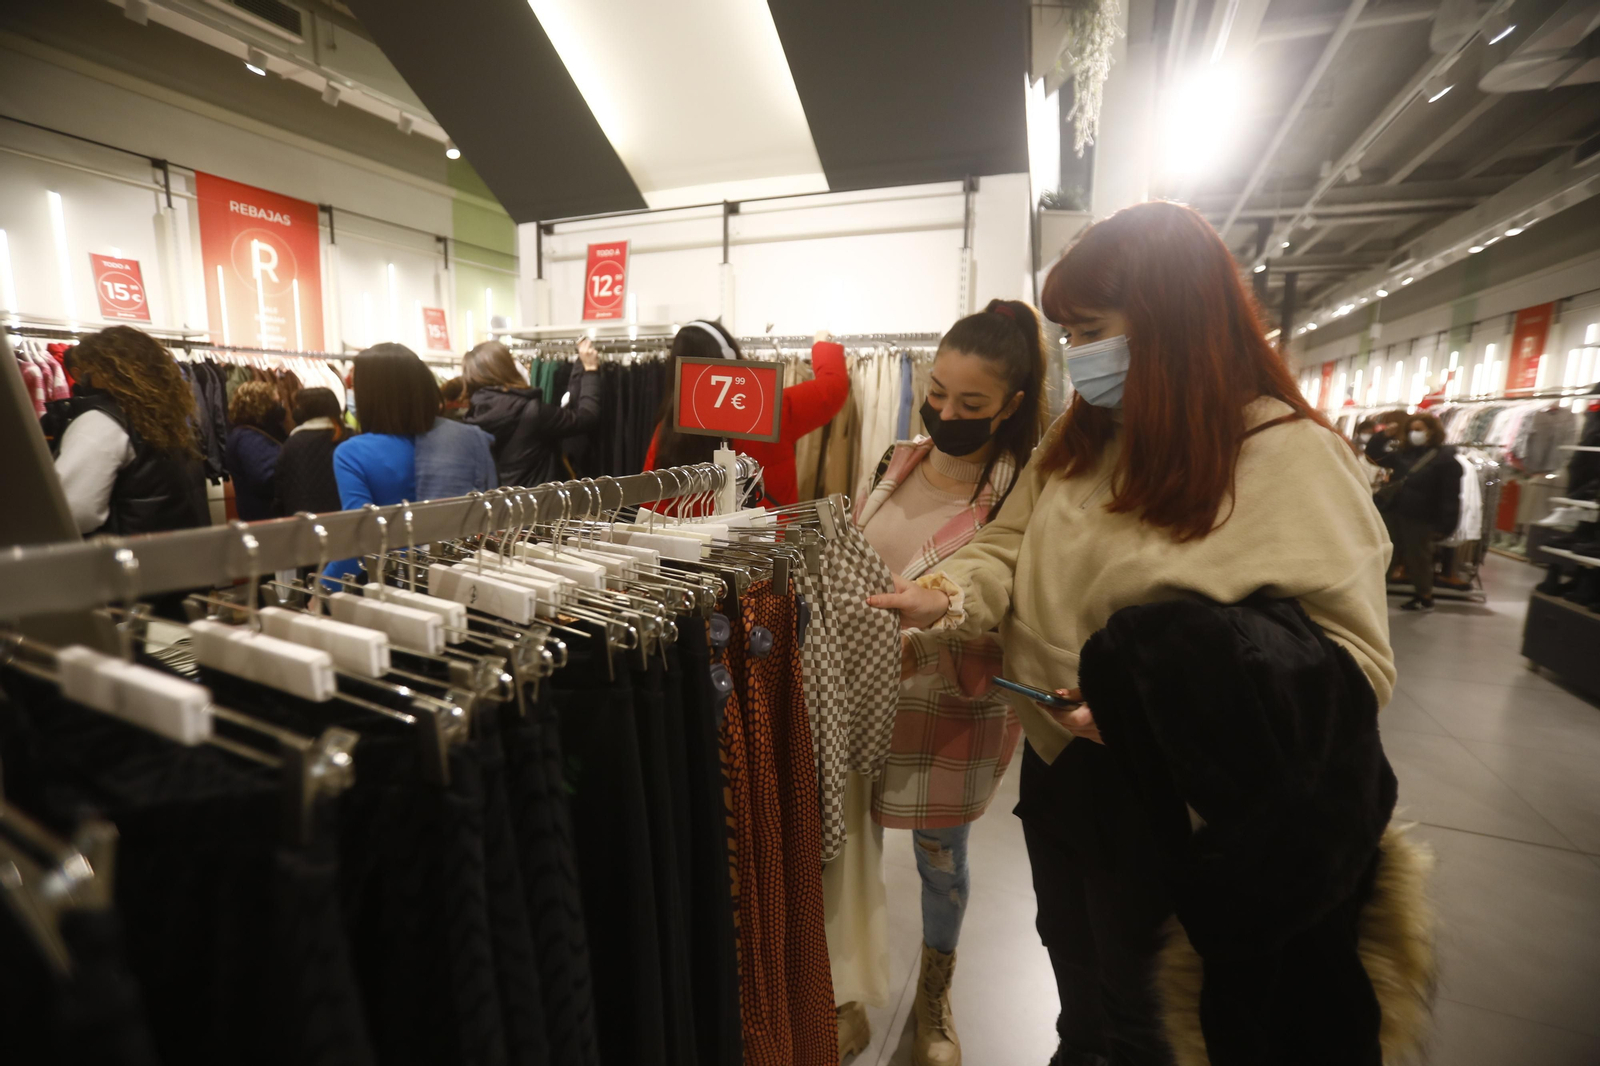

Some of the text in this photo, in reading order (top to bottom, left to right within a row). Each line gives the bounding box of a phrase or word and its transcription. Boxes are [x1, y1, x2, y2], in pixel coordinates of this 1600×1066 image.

[229, 200, 292, 227] REBAJAS
[250, 239, 280, 283] R
[102, 281, 130, 301] 15
[592, 275, 612, 297] 12
[711, 375, 746, 410] 7 €
[735, 377, 745, 385] 99
